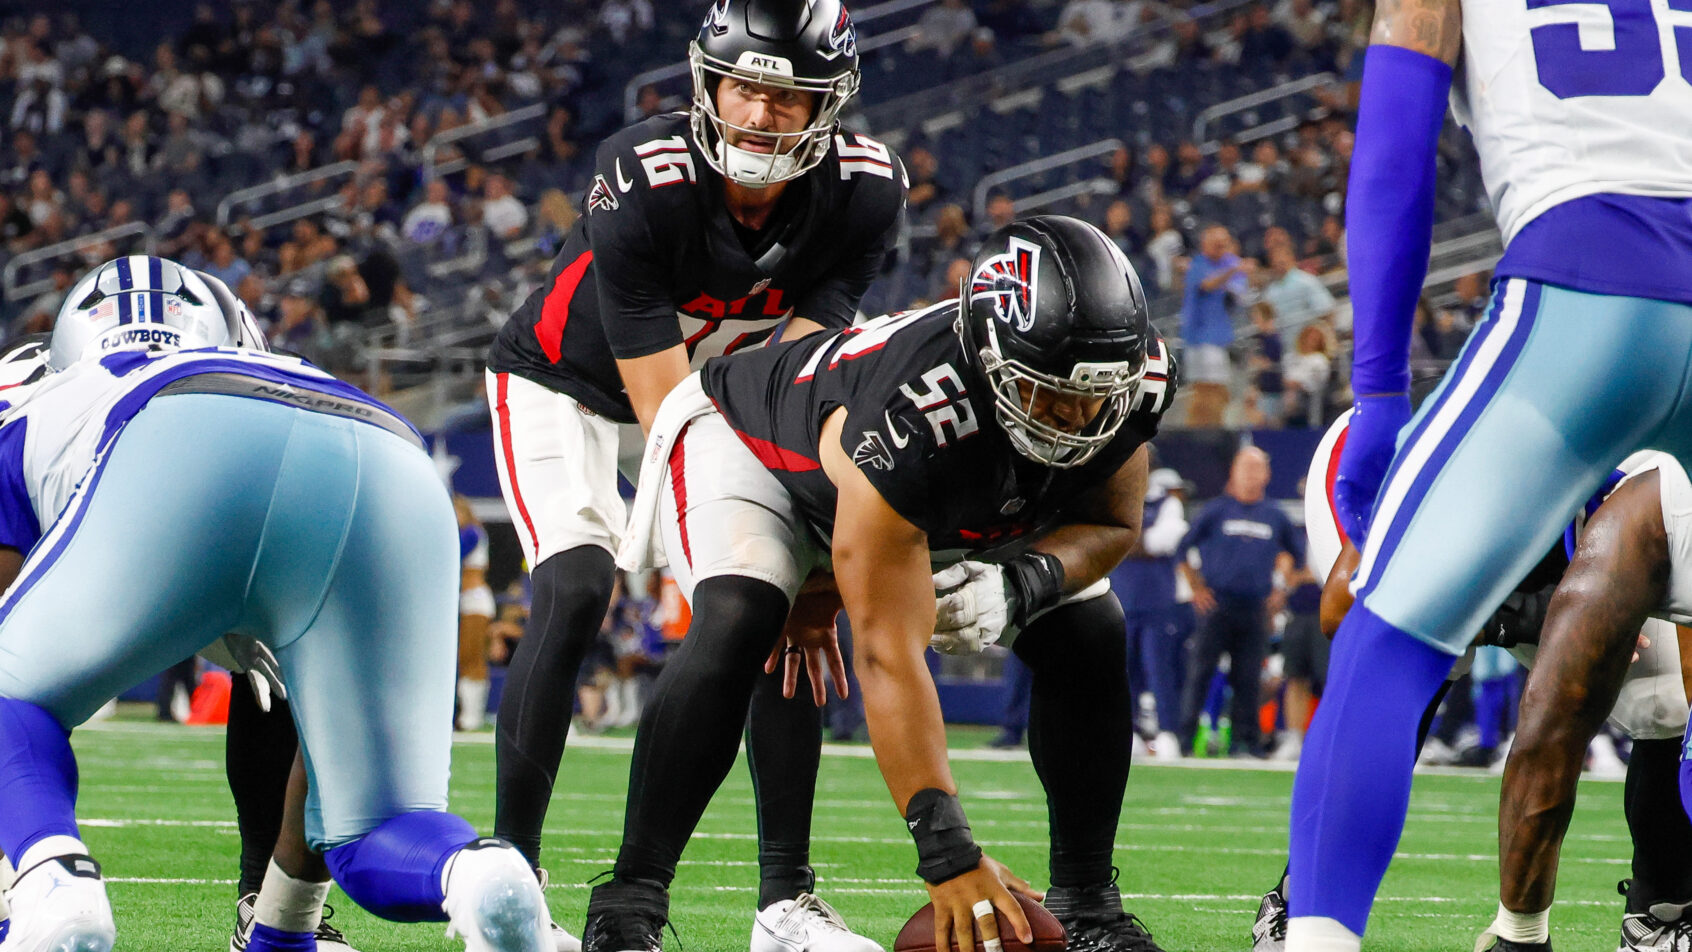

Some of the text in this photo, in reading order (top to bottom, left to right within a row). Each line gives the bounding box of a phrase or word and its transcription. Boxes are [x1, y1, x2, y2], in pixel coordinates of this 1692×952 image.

[751, 57, 780, 70] ATL
[633, 135, 697, 190] 16
[834, 133, 893, 180] 16
[681, 288, 789, 318] ATL
[102, 329, 181, 350] COWBOYS
[313, 399, 373, 417] PRO
[899, 362, 979, 448] 52
